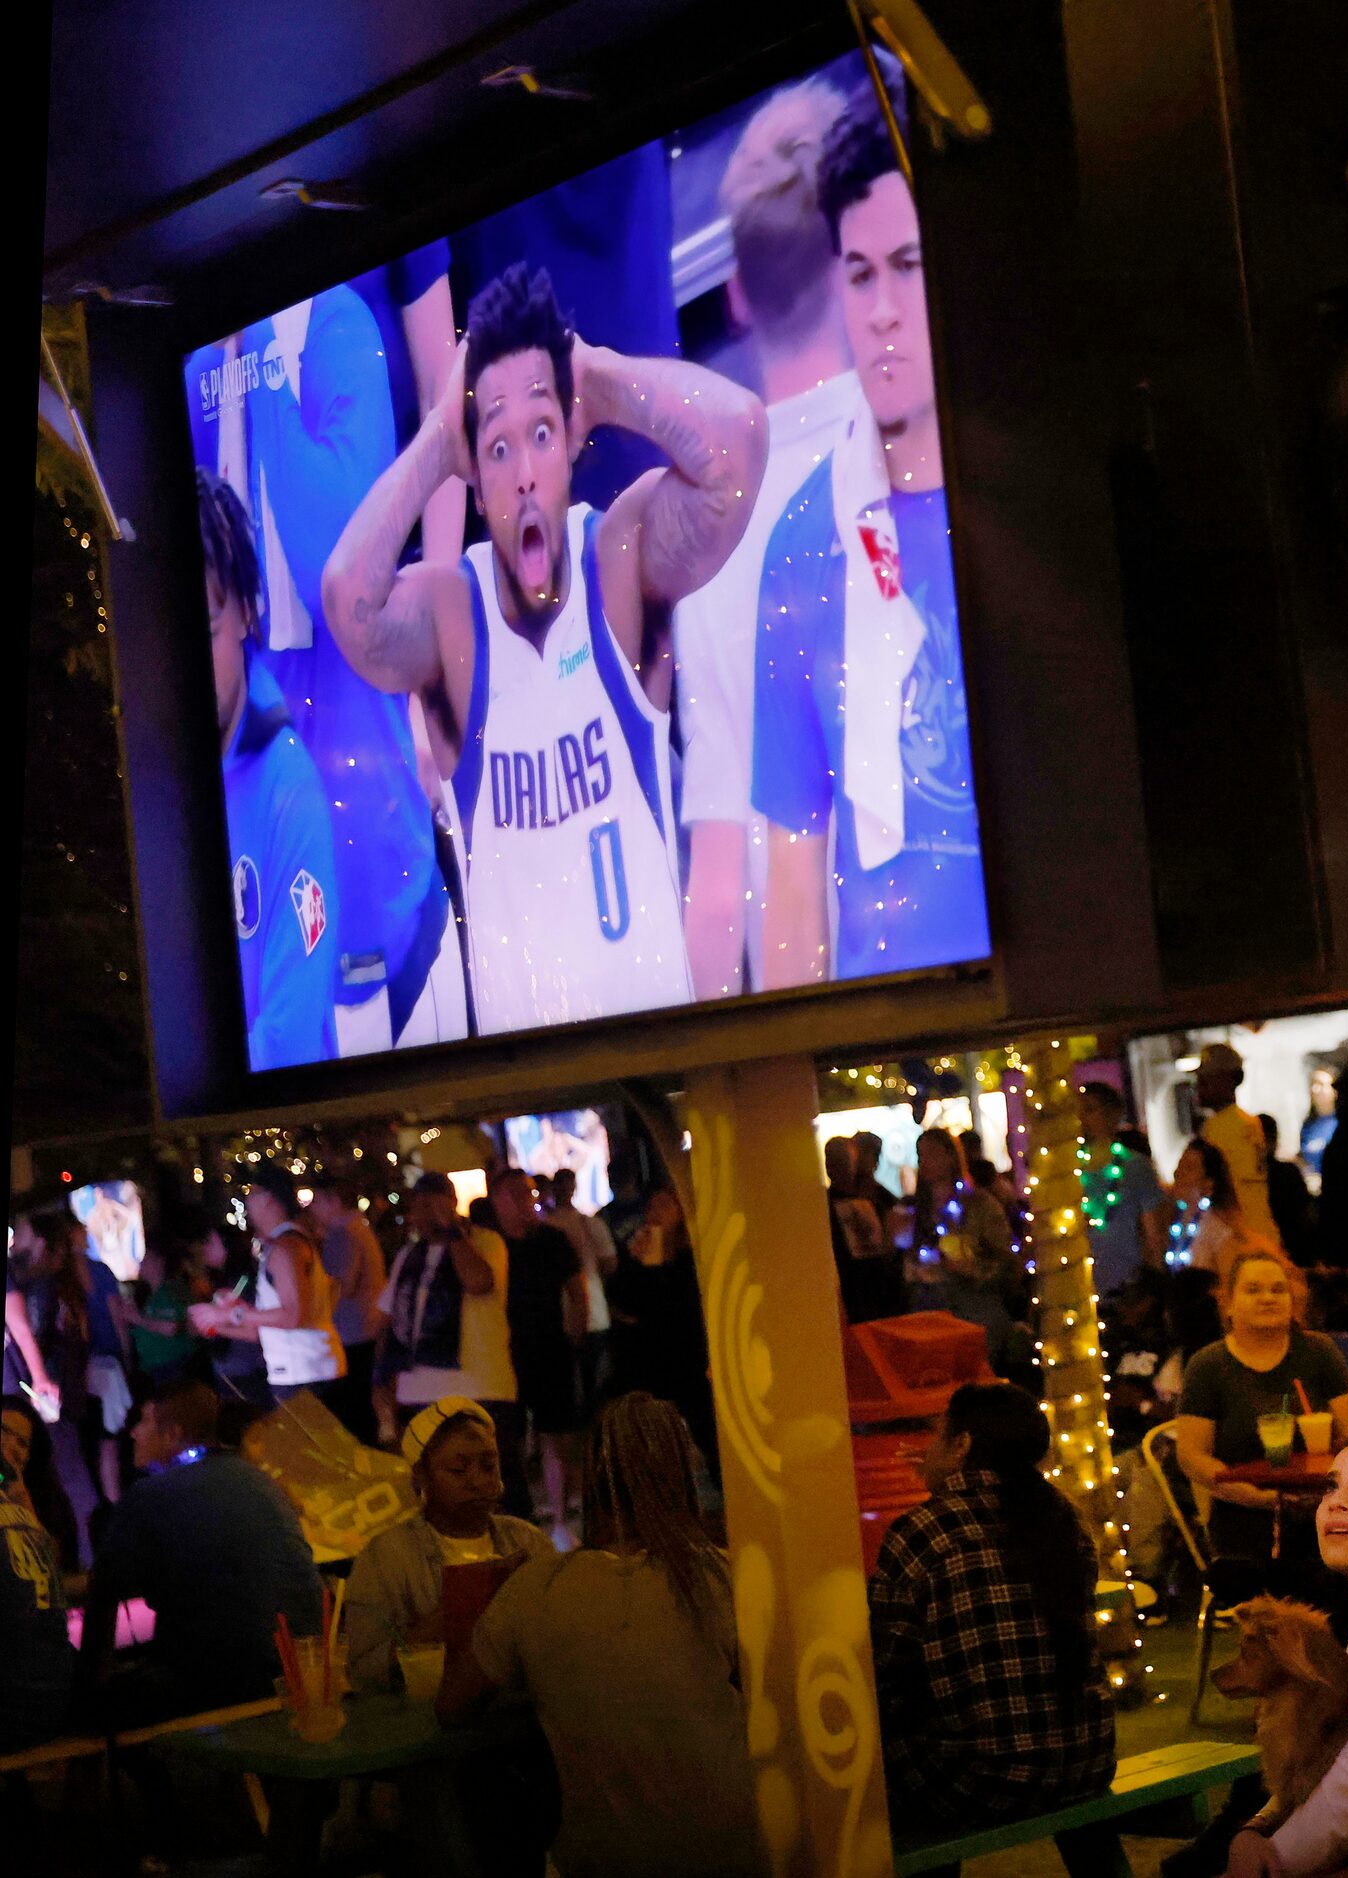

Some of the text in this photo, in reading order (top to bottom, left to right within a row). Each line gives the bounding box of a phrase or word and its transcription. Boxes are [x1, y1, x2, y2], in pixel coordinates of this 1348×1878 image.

[210, 351, 260, 408] PLAYOFFS
[489, 716, 613, 831] DALLAS
[588, 818, 631, 943] 0
